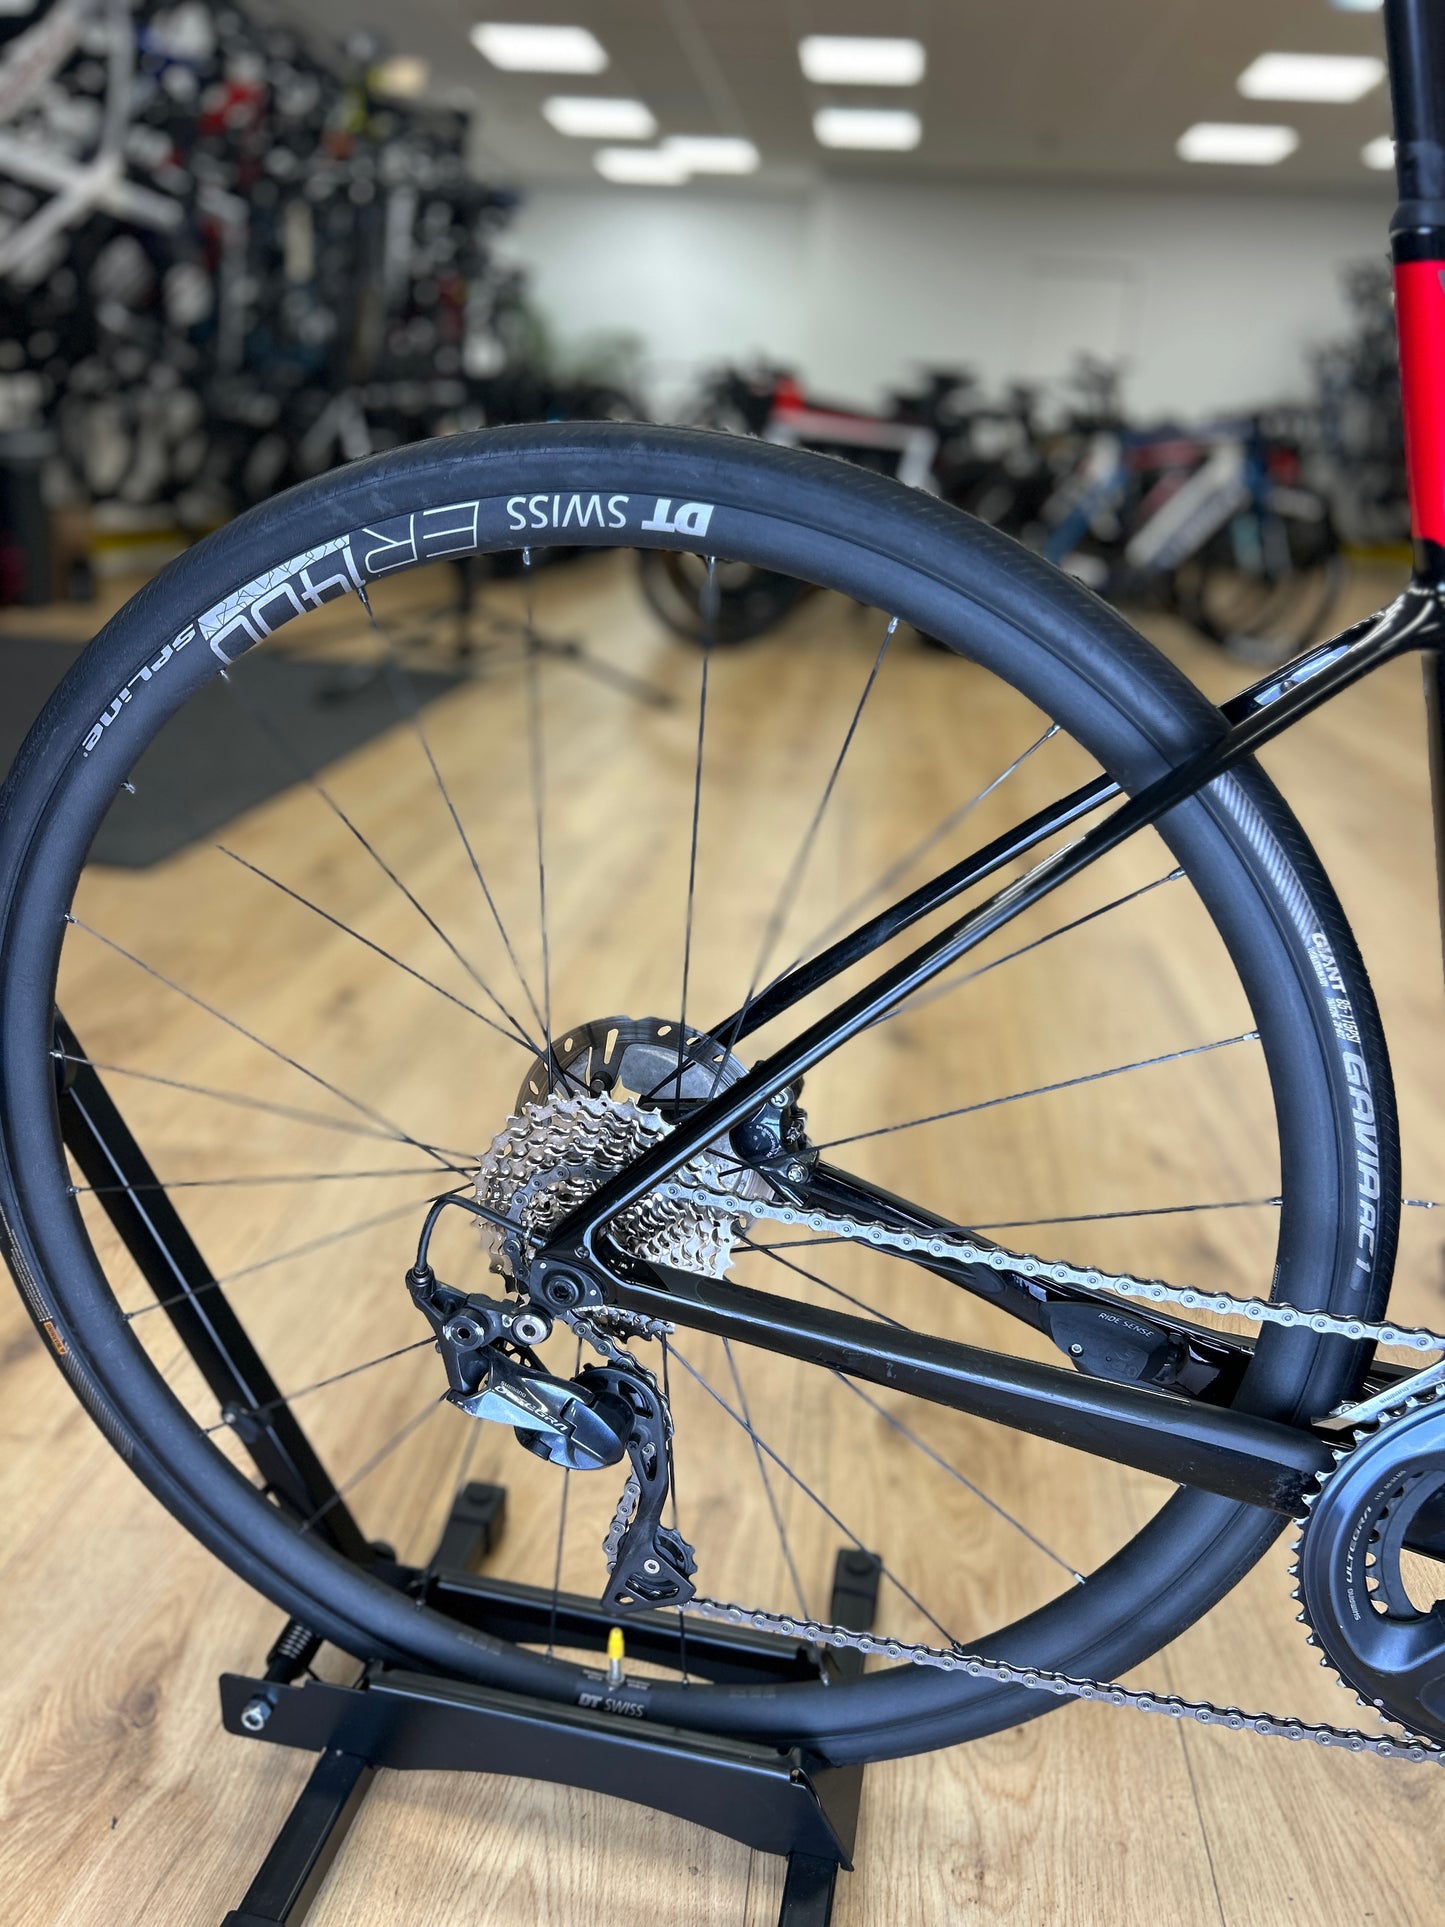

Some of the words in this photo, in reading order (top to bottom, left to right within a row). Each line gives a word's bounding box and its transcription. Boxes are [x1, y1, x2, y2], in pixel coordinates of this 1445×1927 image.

[507, 494, 630, 531] SWISS
[641, 498, 715, 537] DT
[362, 501, 480, 575] ER
[1311, 932, 1347, 994] GIANT
[1342, 1051, 1381, 1200] GAVIA
[1358, 1199, 1376, 1258] AC
[1356, 1251, 1371, 1273] 1
[1098, 1312, 1120, 1324] RIDE
[1123, 1320, 1154, 1338] SENSE
[494, 1385, 568, 1431] UEGRA
[1346, 1505, 1372, 1583] ULTEGRA
[1347, 1587, 1361, 1621] SHIMANO
[578, 1692, 603, 1708] DT
[603, 1697, 645, 1717] SWISS
